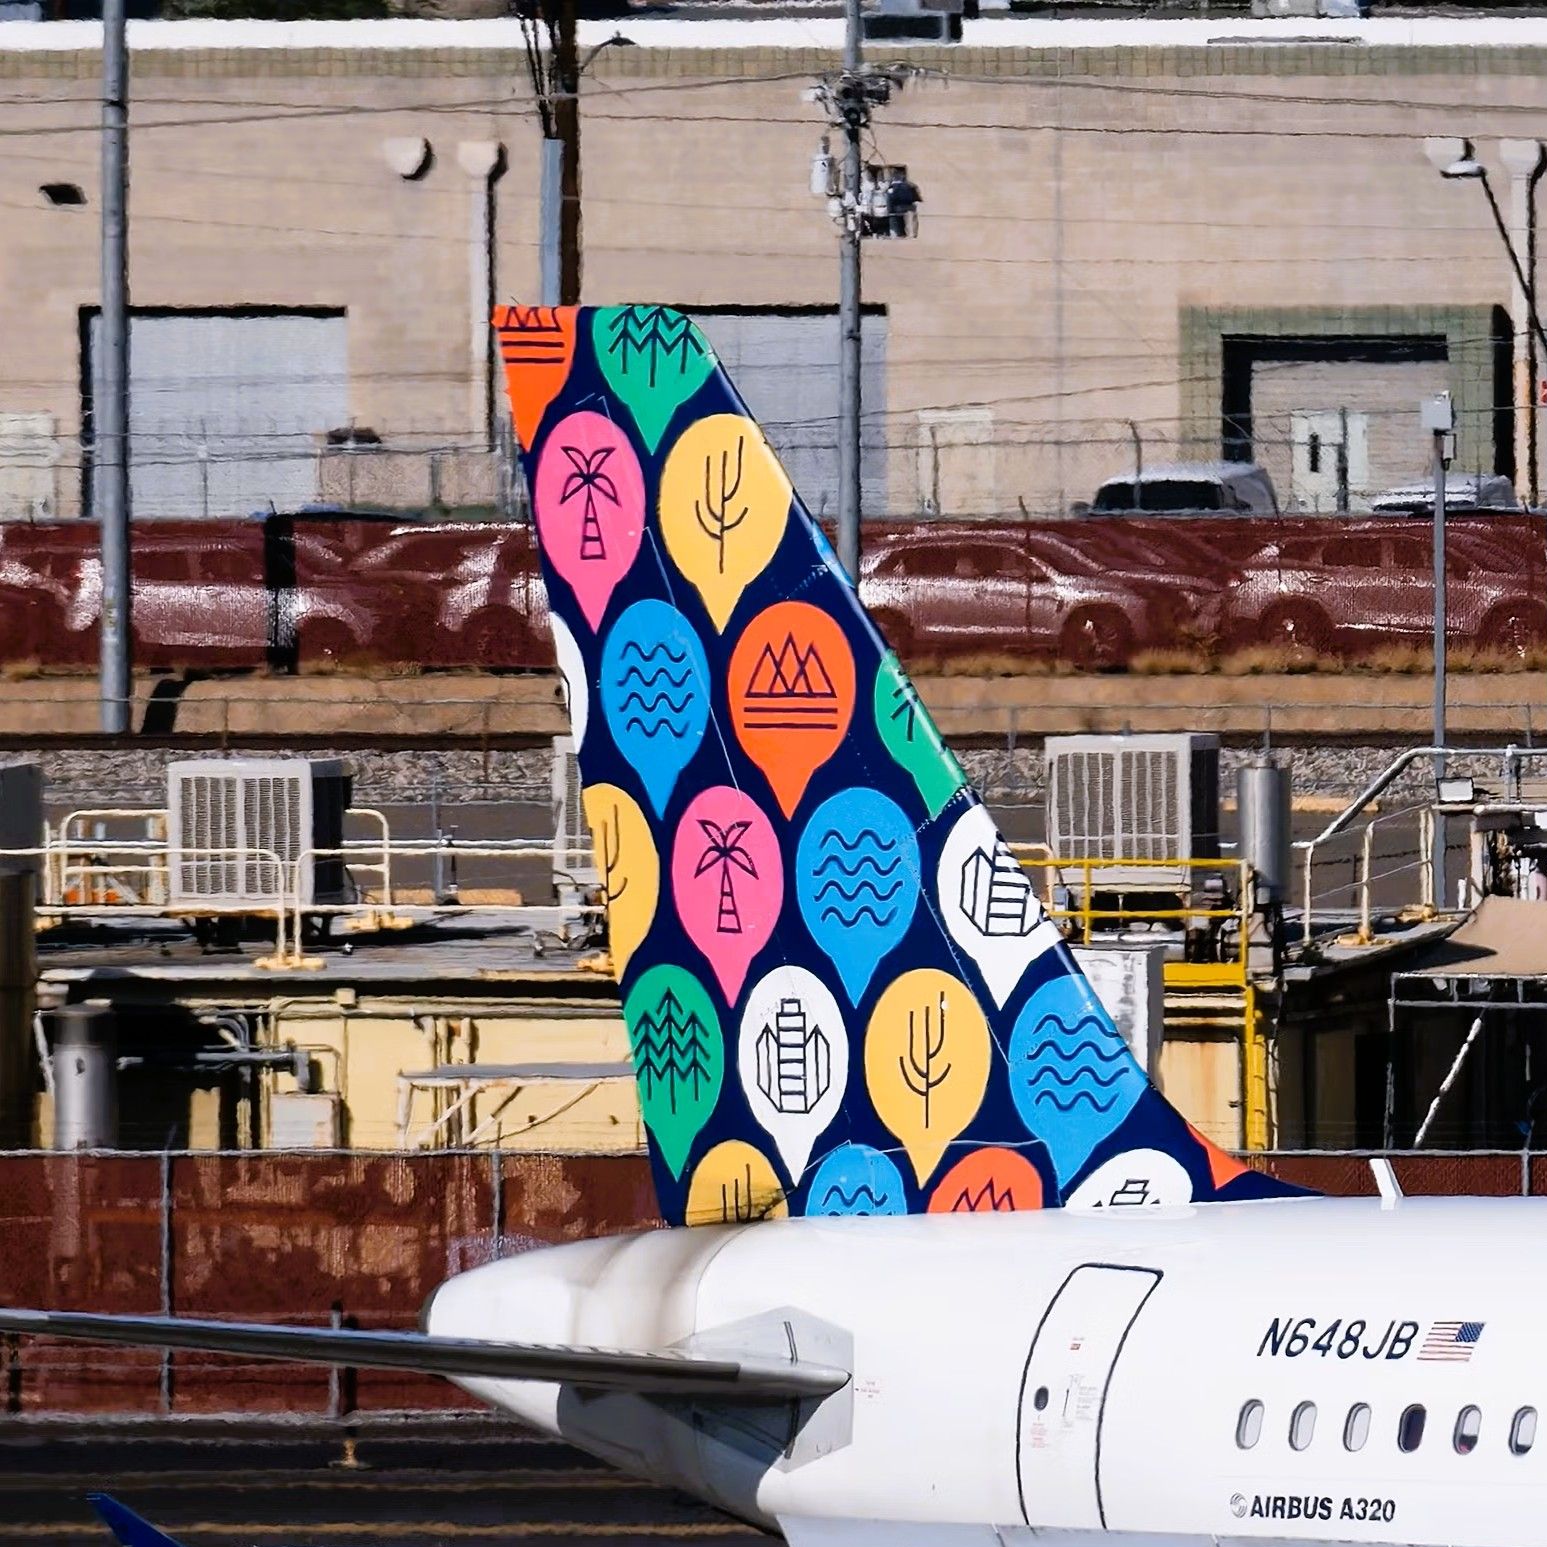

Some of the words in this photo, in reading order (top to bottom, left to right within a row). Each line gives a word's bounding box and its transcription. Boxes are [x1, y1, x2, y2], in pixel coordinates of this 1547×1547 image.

[1256, 1317, 1420, 1360] N648JB
[1250, 1495, 1333, 1520] AIRBUS
[1339, 1497, 1396, 1523] A320
